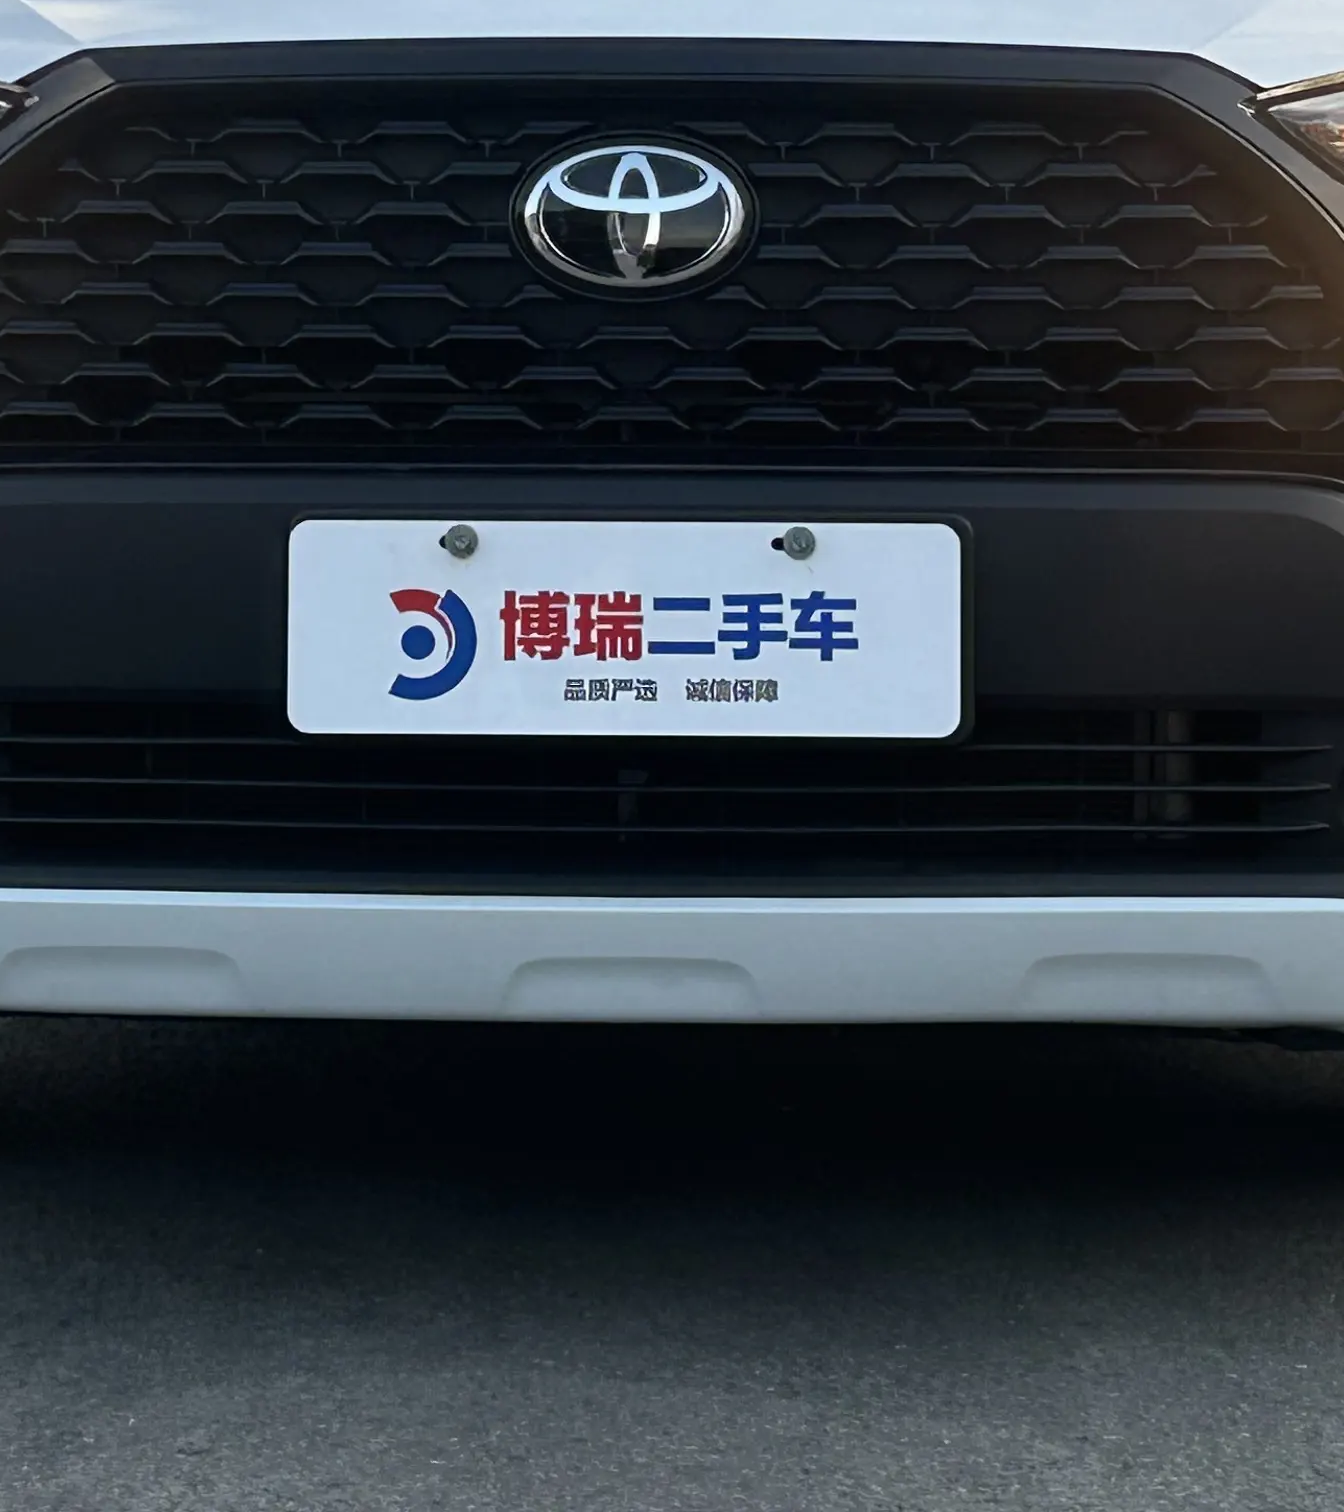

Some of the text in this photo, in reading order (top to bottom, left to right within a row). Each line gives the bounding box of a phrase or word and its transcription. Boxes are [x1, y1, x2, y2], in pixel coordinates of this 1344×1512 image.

[500, 590, 859, 662] 博瑞二手车
[563, 678, 779, 702] 品质严选 诚信保障
